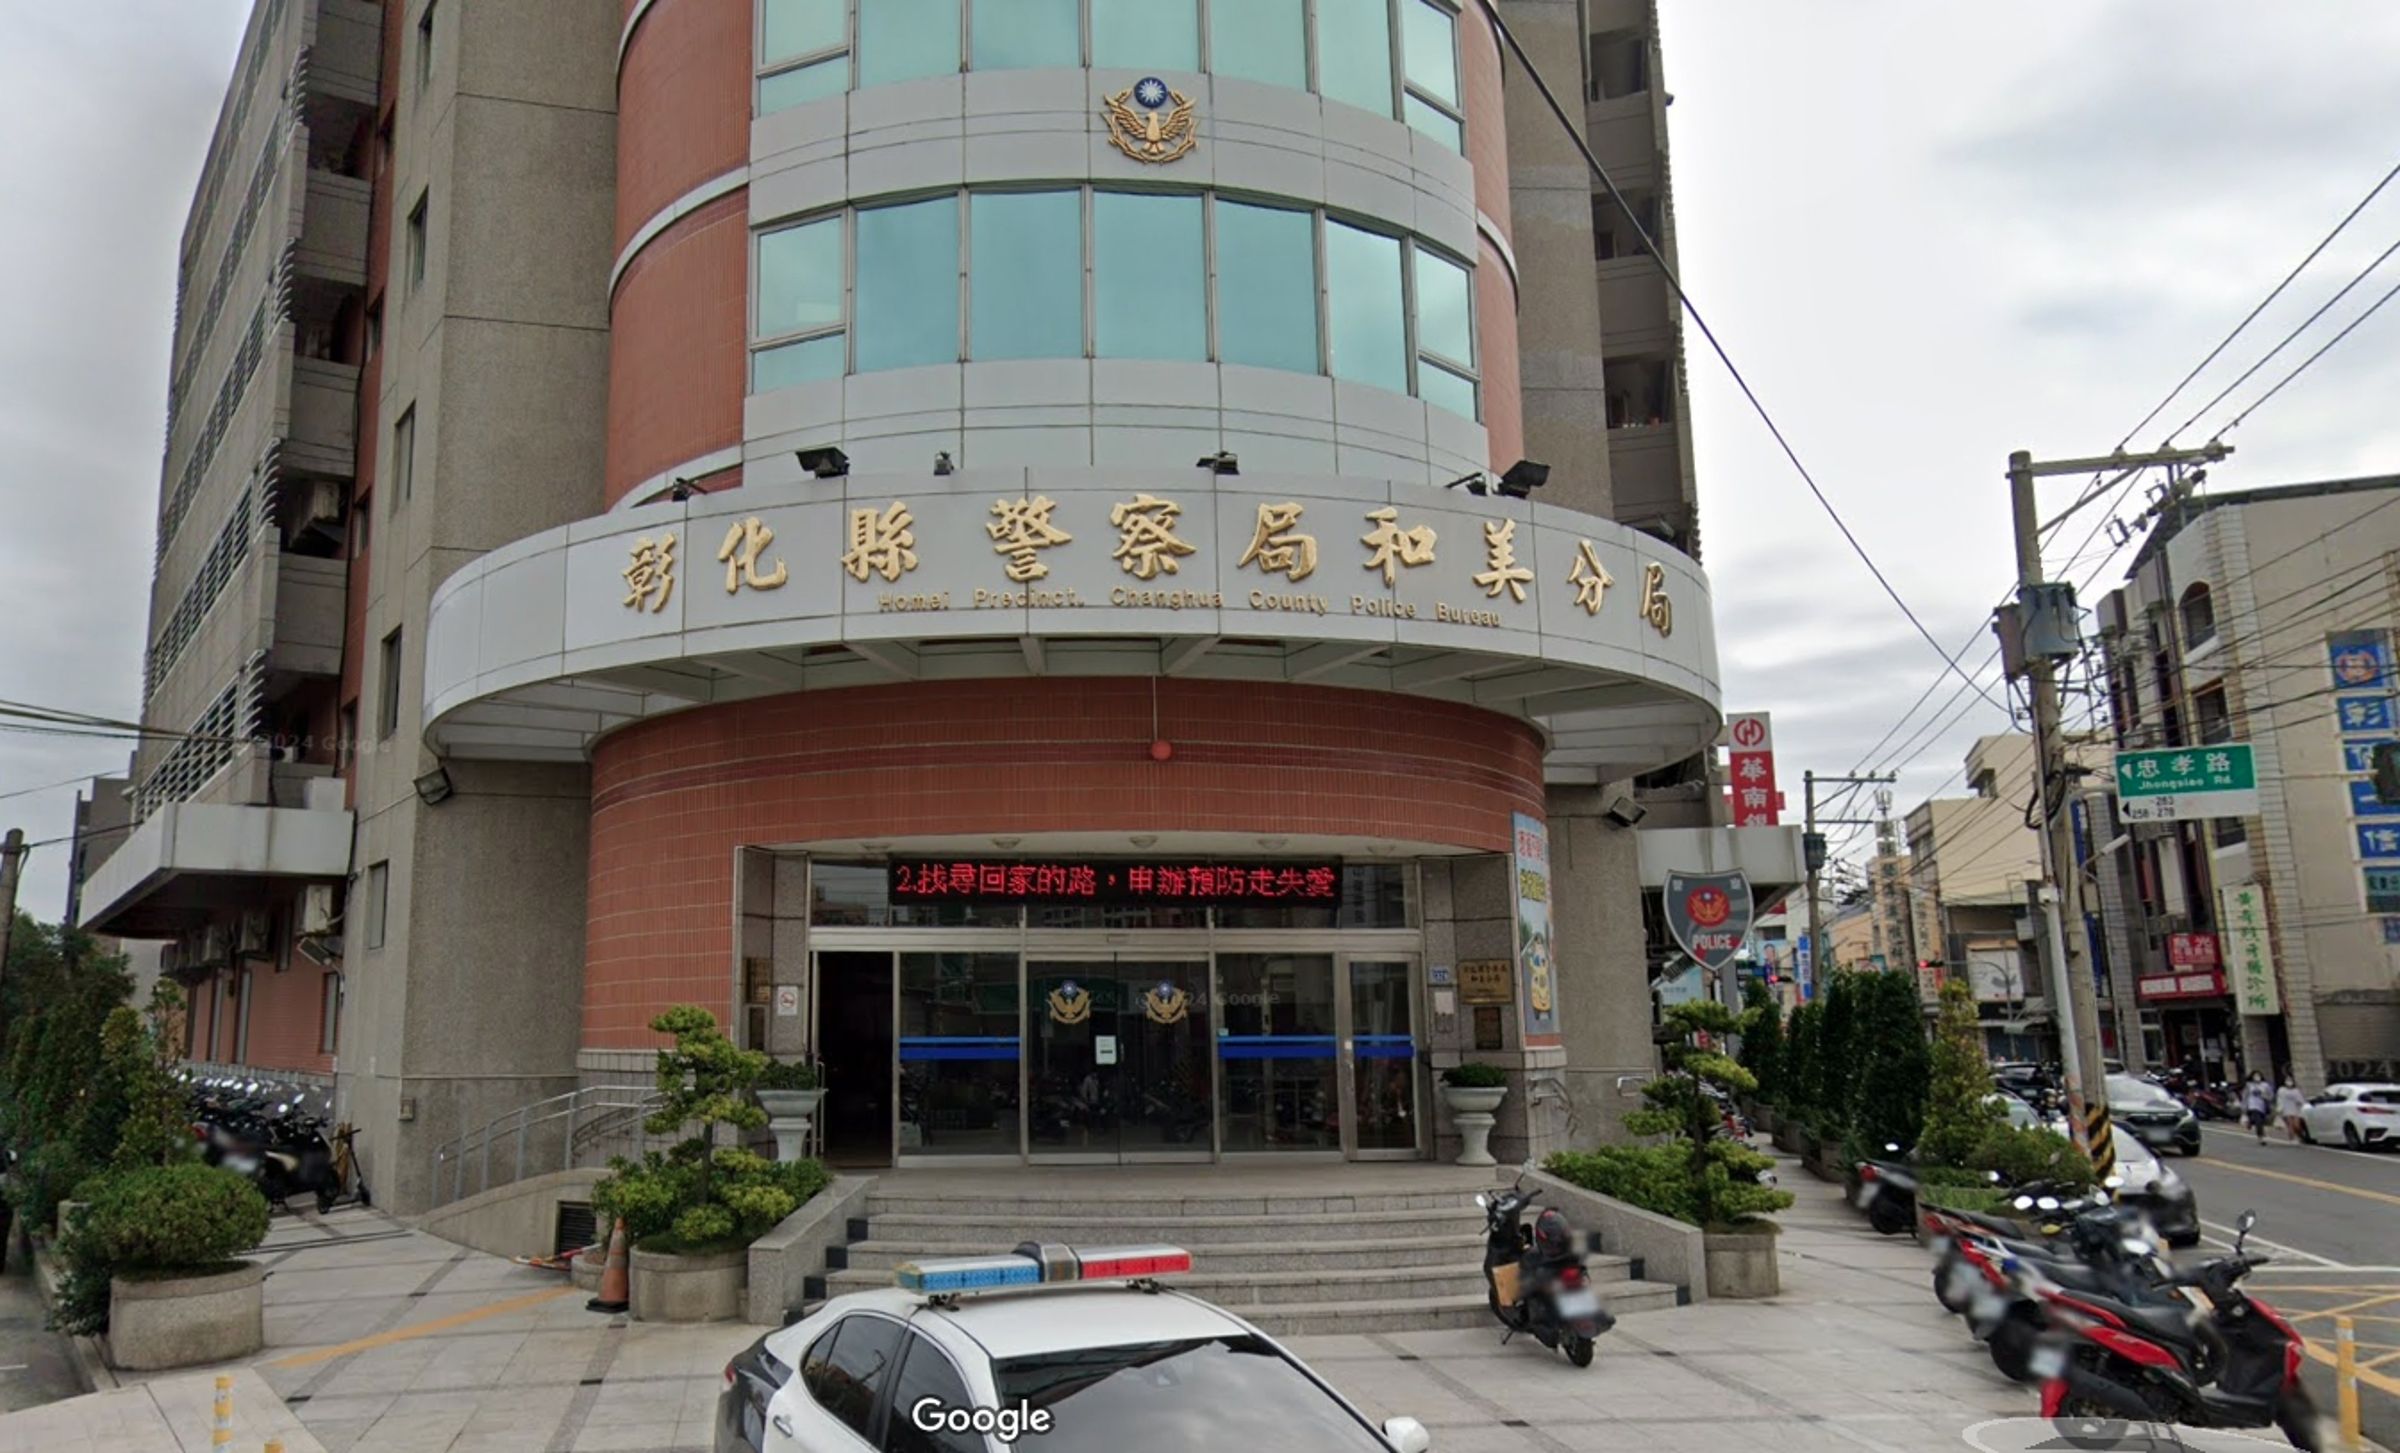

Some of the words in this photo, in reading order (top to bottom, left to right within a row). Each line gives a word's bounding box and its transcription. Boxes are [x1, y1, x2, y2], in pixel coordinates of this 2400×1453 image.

[622, 494, 1673, 638] 彰化縣警察局和美分局
[877, 591, 950, 613] Homei
[1110, 585, 1223, 611] Changhua
[1250, 589, 1328, 616] County
[1351, 594, 1417, 618] Police
[1436, 602, 1501, 627] Bureau
[2136, 751, 2231, 779] 忠孝路
[1692, 933, 1732, 950] POLICE
